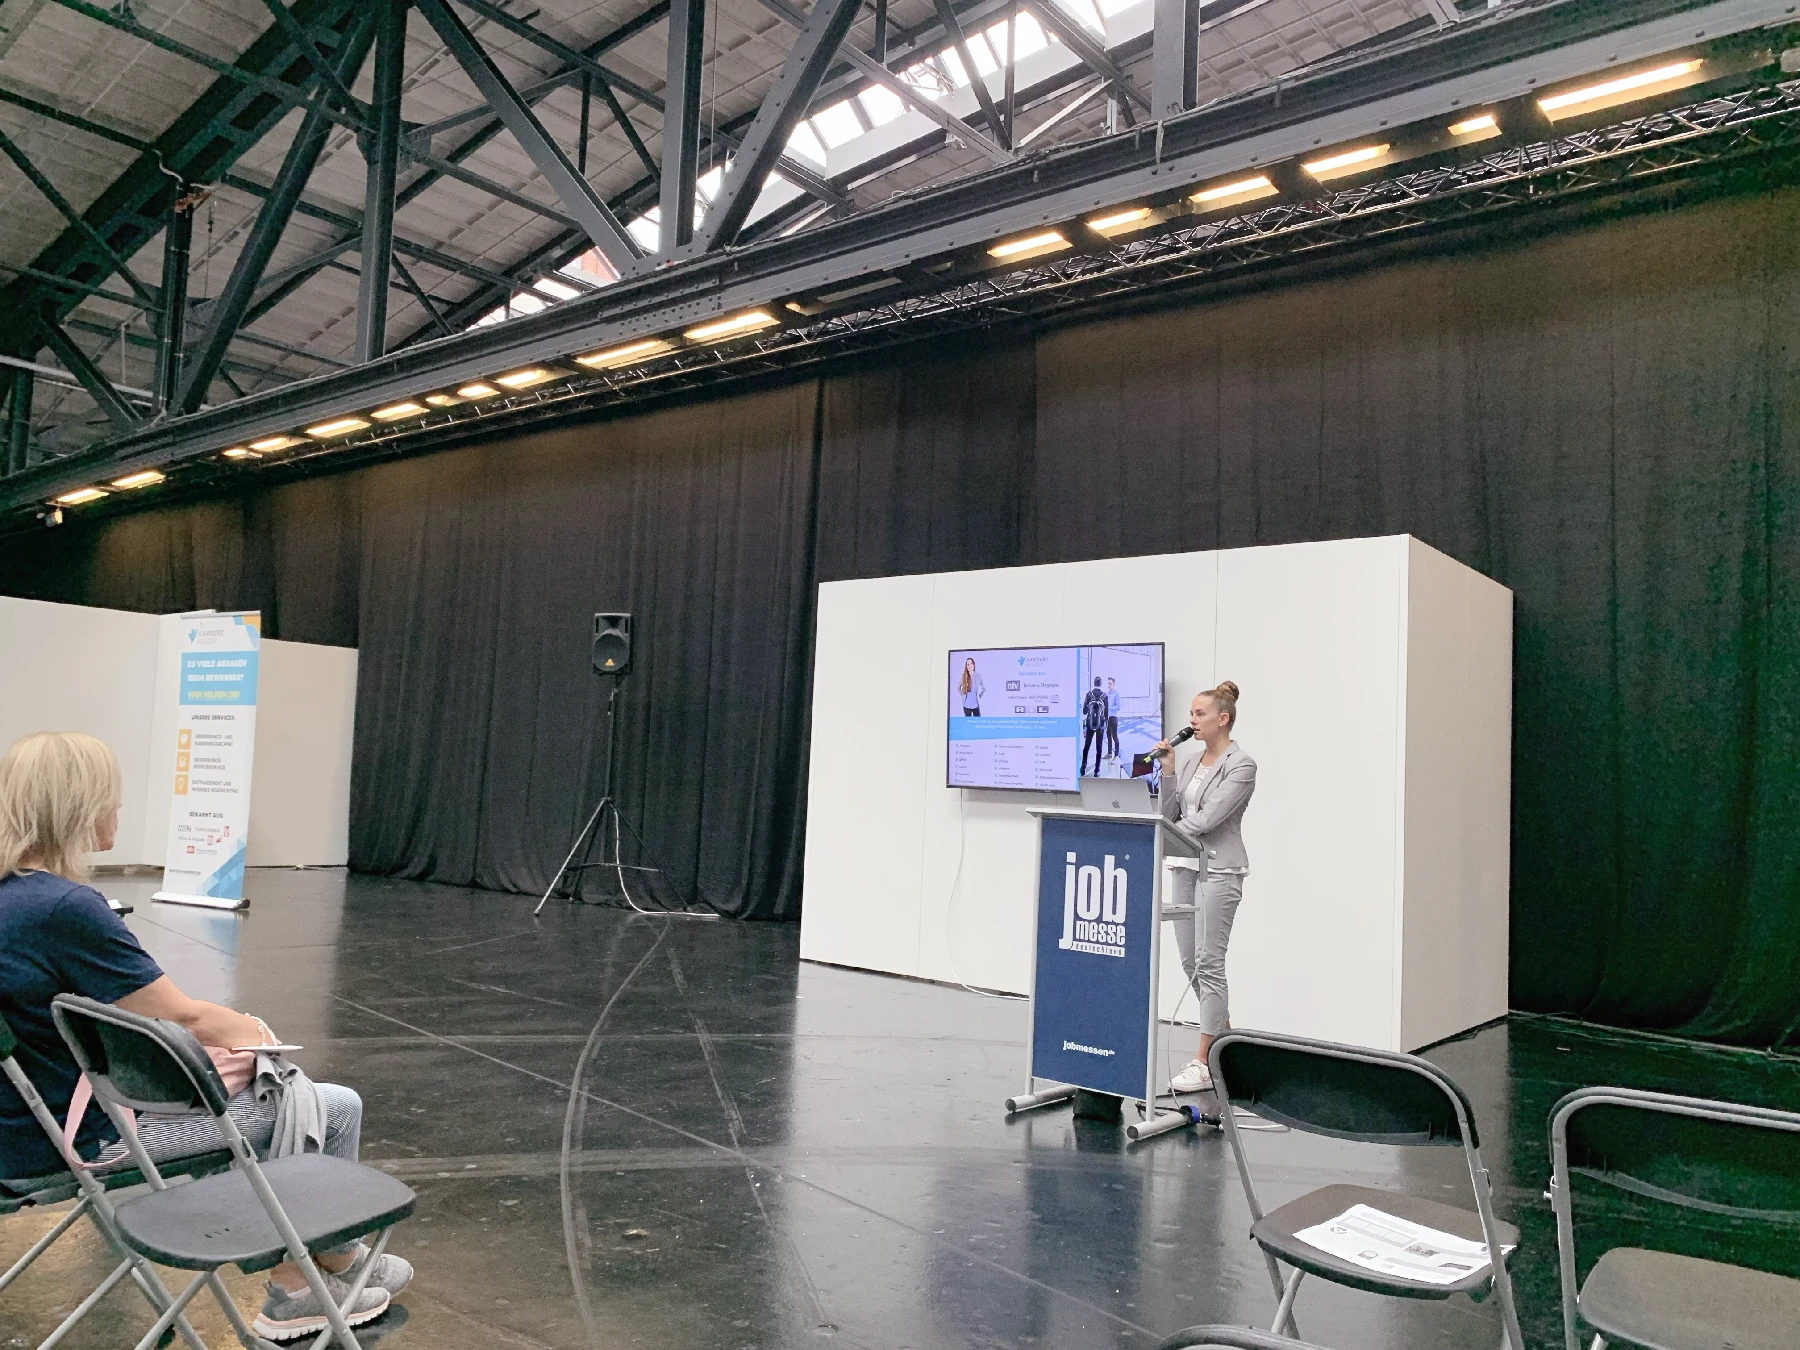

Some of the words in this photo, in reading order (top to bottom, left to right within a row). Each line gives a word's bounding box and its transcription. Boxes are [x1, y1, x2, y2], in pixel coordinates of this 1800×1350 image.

[186, 660, 196, 668] ZU
[197, 660, 216, 668] VIELE
[216, 659, 248, 668] ABSAGEN
[205, 674, 245, 682] BEWERBEN?
[1059, 851, 1128, 950] job
[1075, 920, 1126, 946] messe
[1075, 943, 1122, 956] deutschland
